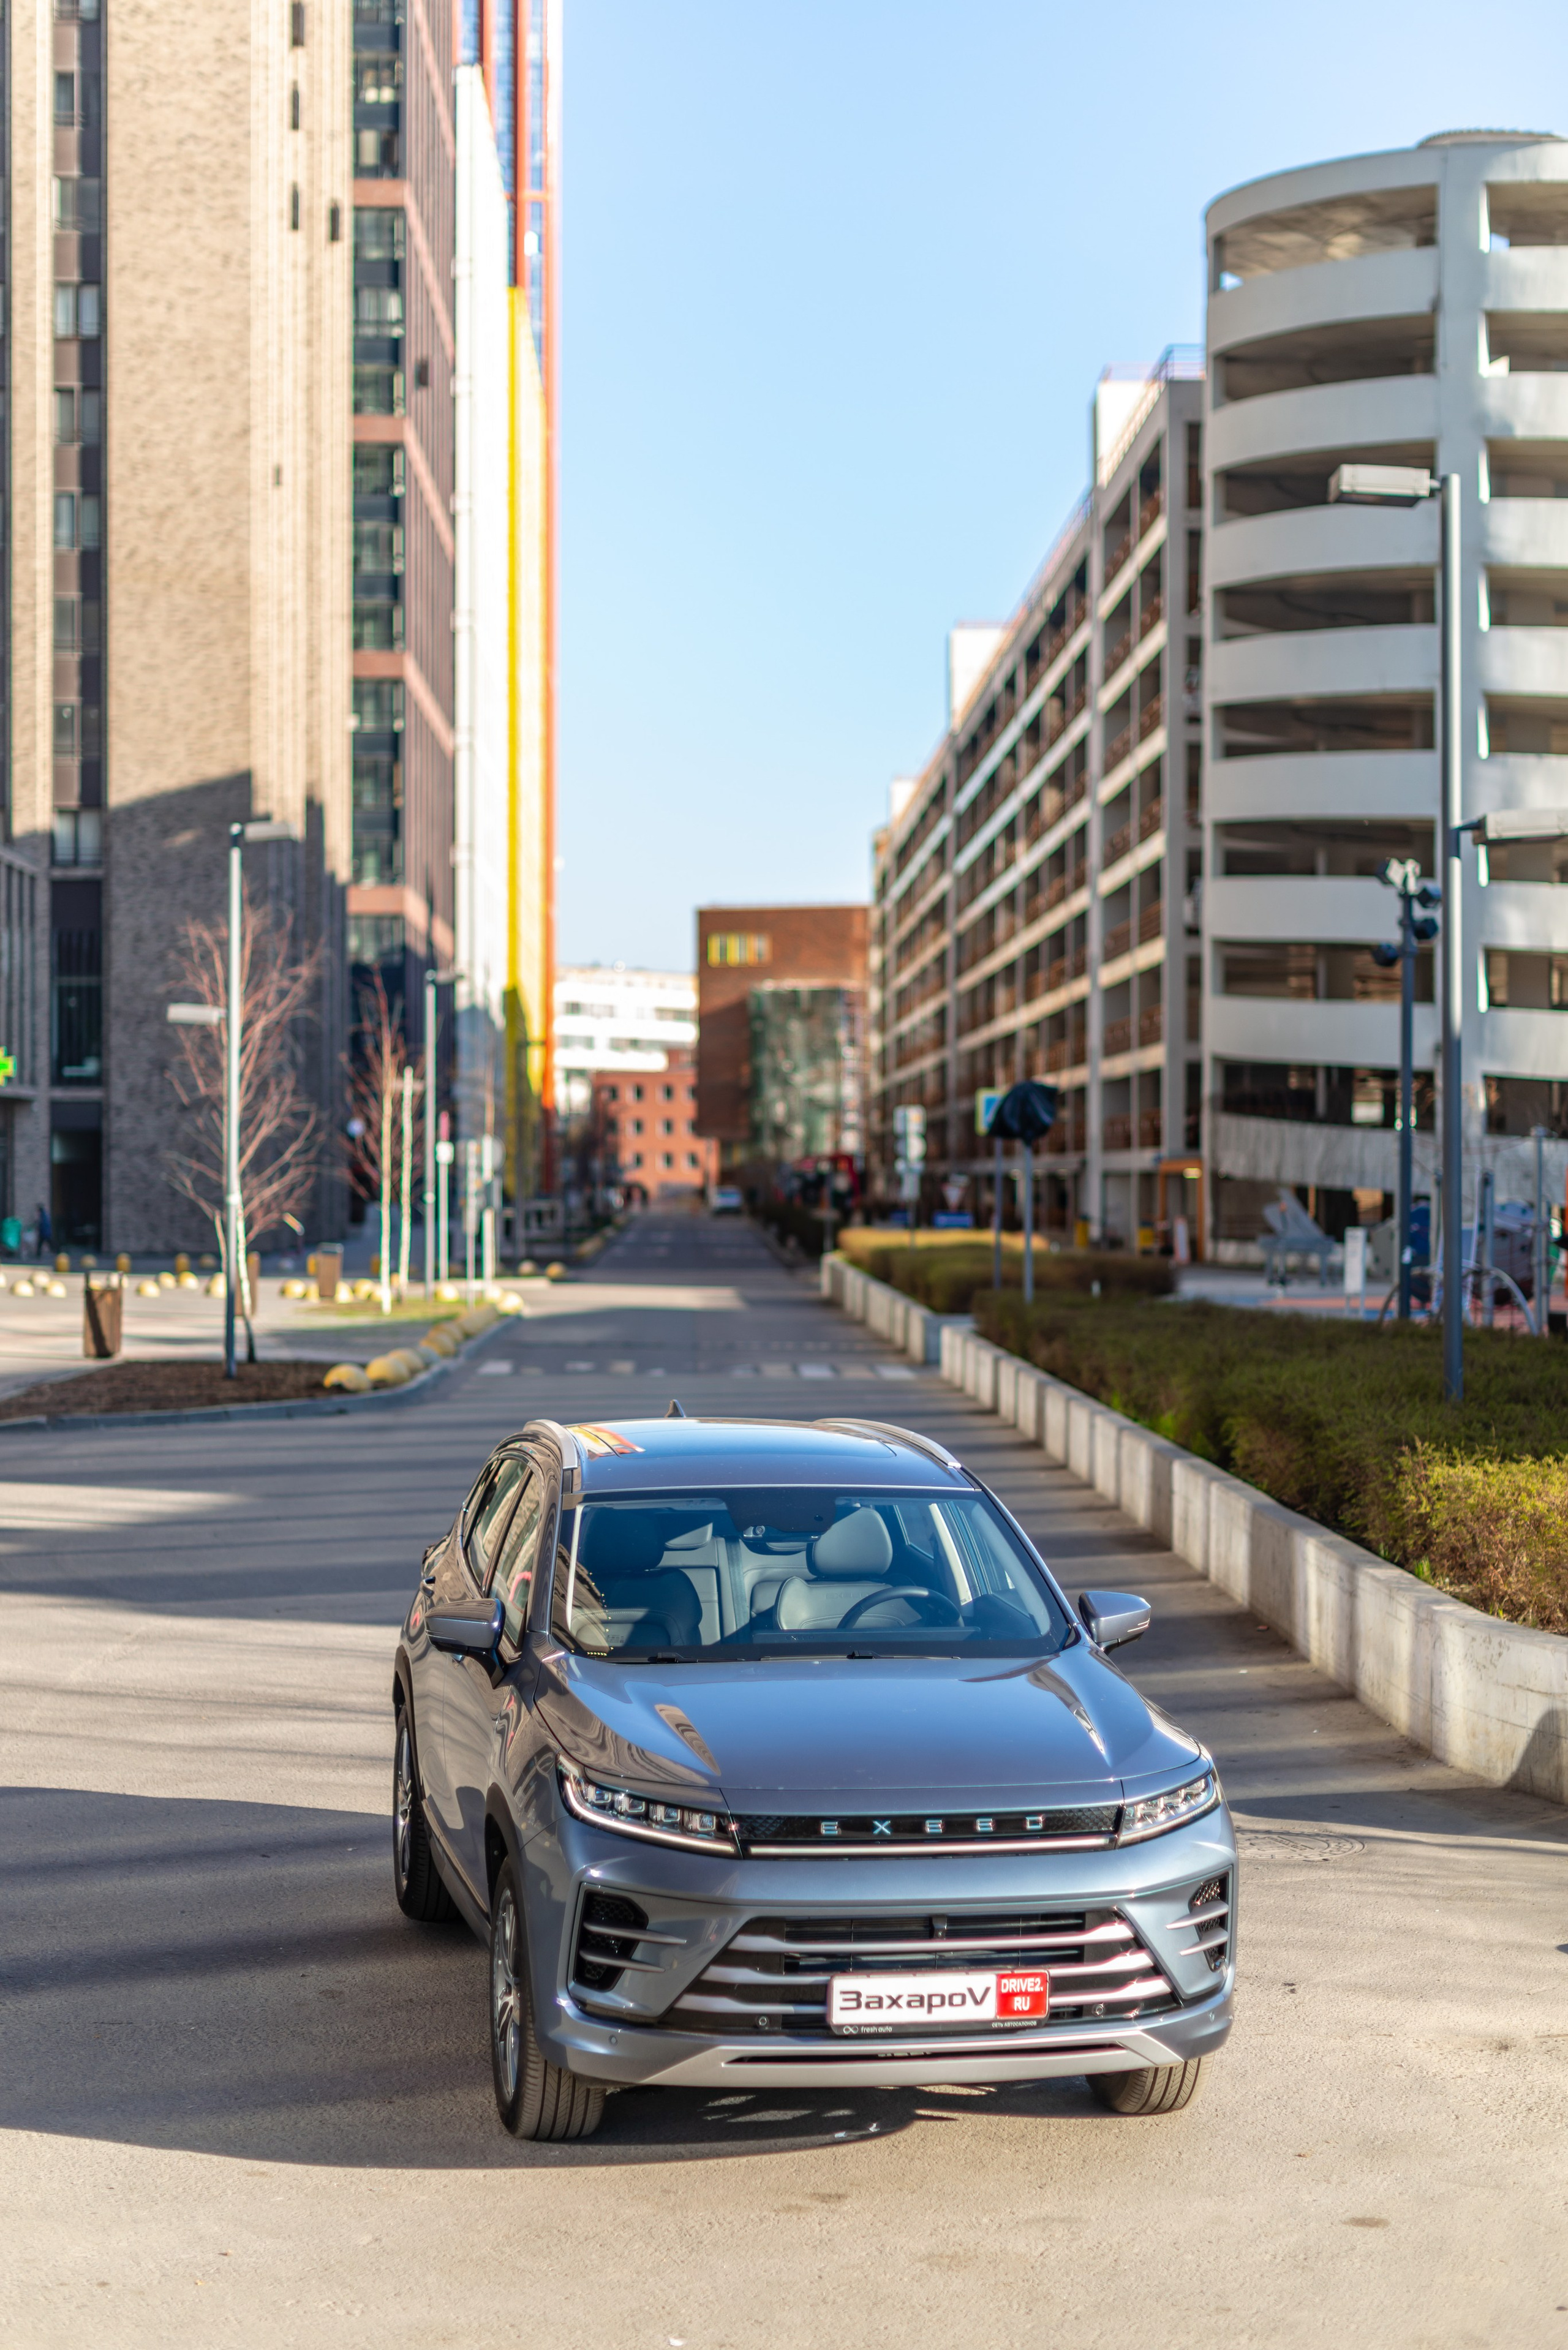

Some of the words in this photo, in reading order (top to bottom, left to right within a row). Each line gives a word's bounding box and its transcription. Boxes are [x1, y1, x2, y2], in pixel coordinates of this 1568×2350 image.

[821, 1815, 1043, 1836] EXEED
[1001, 1978, 1043, 1993] DRIVE2.
[1014, 1997, 1030, 2011] RU
